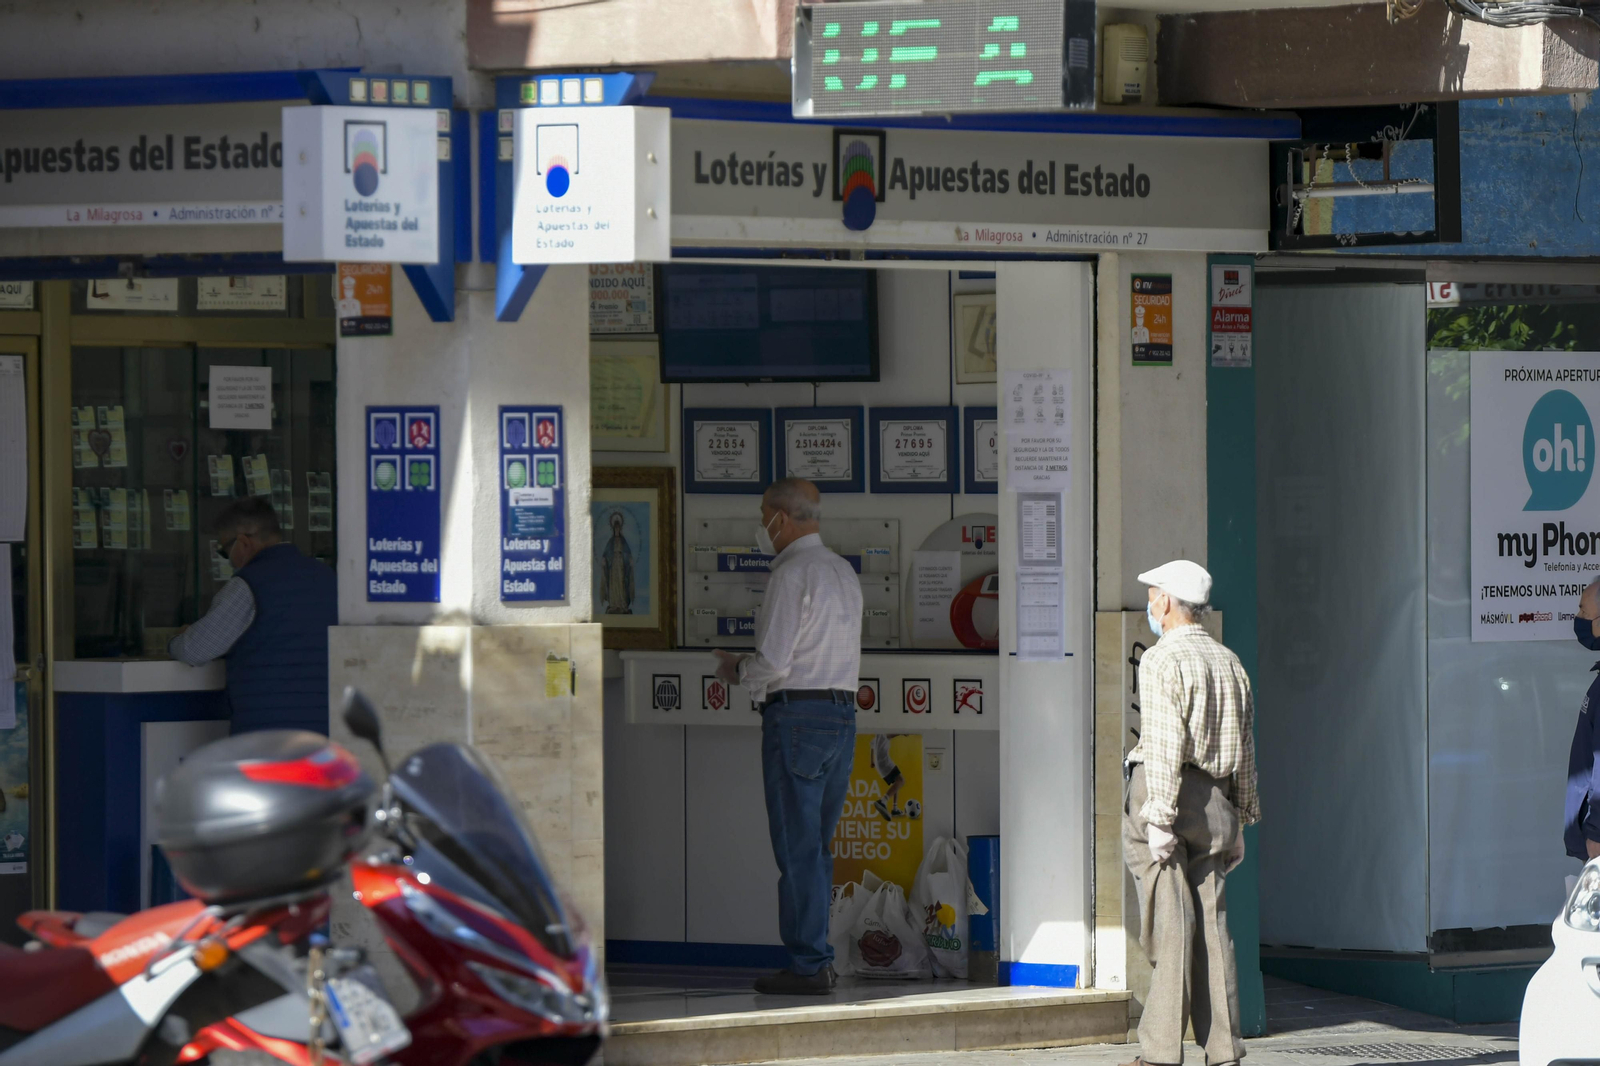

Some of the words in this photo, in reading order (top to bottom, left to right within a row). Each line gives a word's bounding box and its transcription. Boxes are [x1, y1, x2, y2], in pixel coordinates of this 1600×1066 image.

[0, 138, 120, 183] puestas
[129, 134, 174, 171] del
[183, 131, 283, 170] Estado
[694, 150, 805, 187] Loterías
[812, 162, 827, 198] y
[888, 157, 1010, 200] Apuestas
[1018, 159, 1056, 195] del
[1064, 163, 1151, 198] Estado
[66, 208, 80, 222] La
[87, 207, 143, 223] Milagrosa
[169, 205, 256, 220] Administración
[345, 217, 398, 233] Apuestas
[402, 217, 418, 231] del
[345, 234, 385, 248] Estado
[536, 237, 575, 249] Estado
[957, 228, 969, 242] La
[975, 228, 1023, 245] Milagrosa
[1045, 229, 1119, 245] Administración
[1137, 232, 1148, 245] 27
[621, 273, 646, 289] AQUÍ
[1134, 294, 1170, 306] SEGURIDAD
[1153, 313, 1167, 324] 24h
[1214, 310, 1250, 322] Alarma
[1504, 366, 1553, 382] PRÓXIMA
[795, 438, 836, 449] 2.514.424
[895, 438, 933, 449] 27695
[1532, 423, 1586, 472] oh!
[822, 449, 835, 457] AQUÍ
[369, 536, 413, 551] Loterías
[415, 540, 422, 554] y
[503, 536, 541, 551] Loterías
[542, 538, 549, 552] y
[369, 558, 418, 575] Apuestas
[420, 558, 438, 572] del
[503, 557, 546, 575] Apuestas
[547, 556, 563, 571] del
[739, 557, 770, 566] Loterías
[1577, 563, 1582, 573] y
[1582, 562, 1600, 571] Acce
[369, 579, 407, 593] Estado
[503, 578, 535, 593] Estado
[1481, 585, 1533, 600] ¡TENEMOS
[1535, 584, 1557, 597] UNA
[1480, 611, 1514, 624] MÁSMÓVIL
[842, 800, 879, 818] DAD
[834, 820, 881, 839] TIENE
[886, 821, 911, 839] SU
[831, 841, 892, 861] JUEGO
